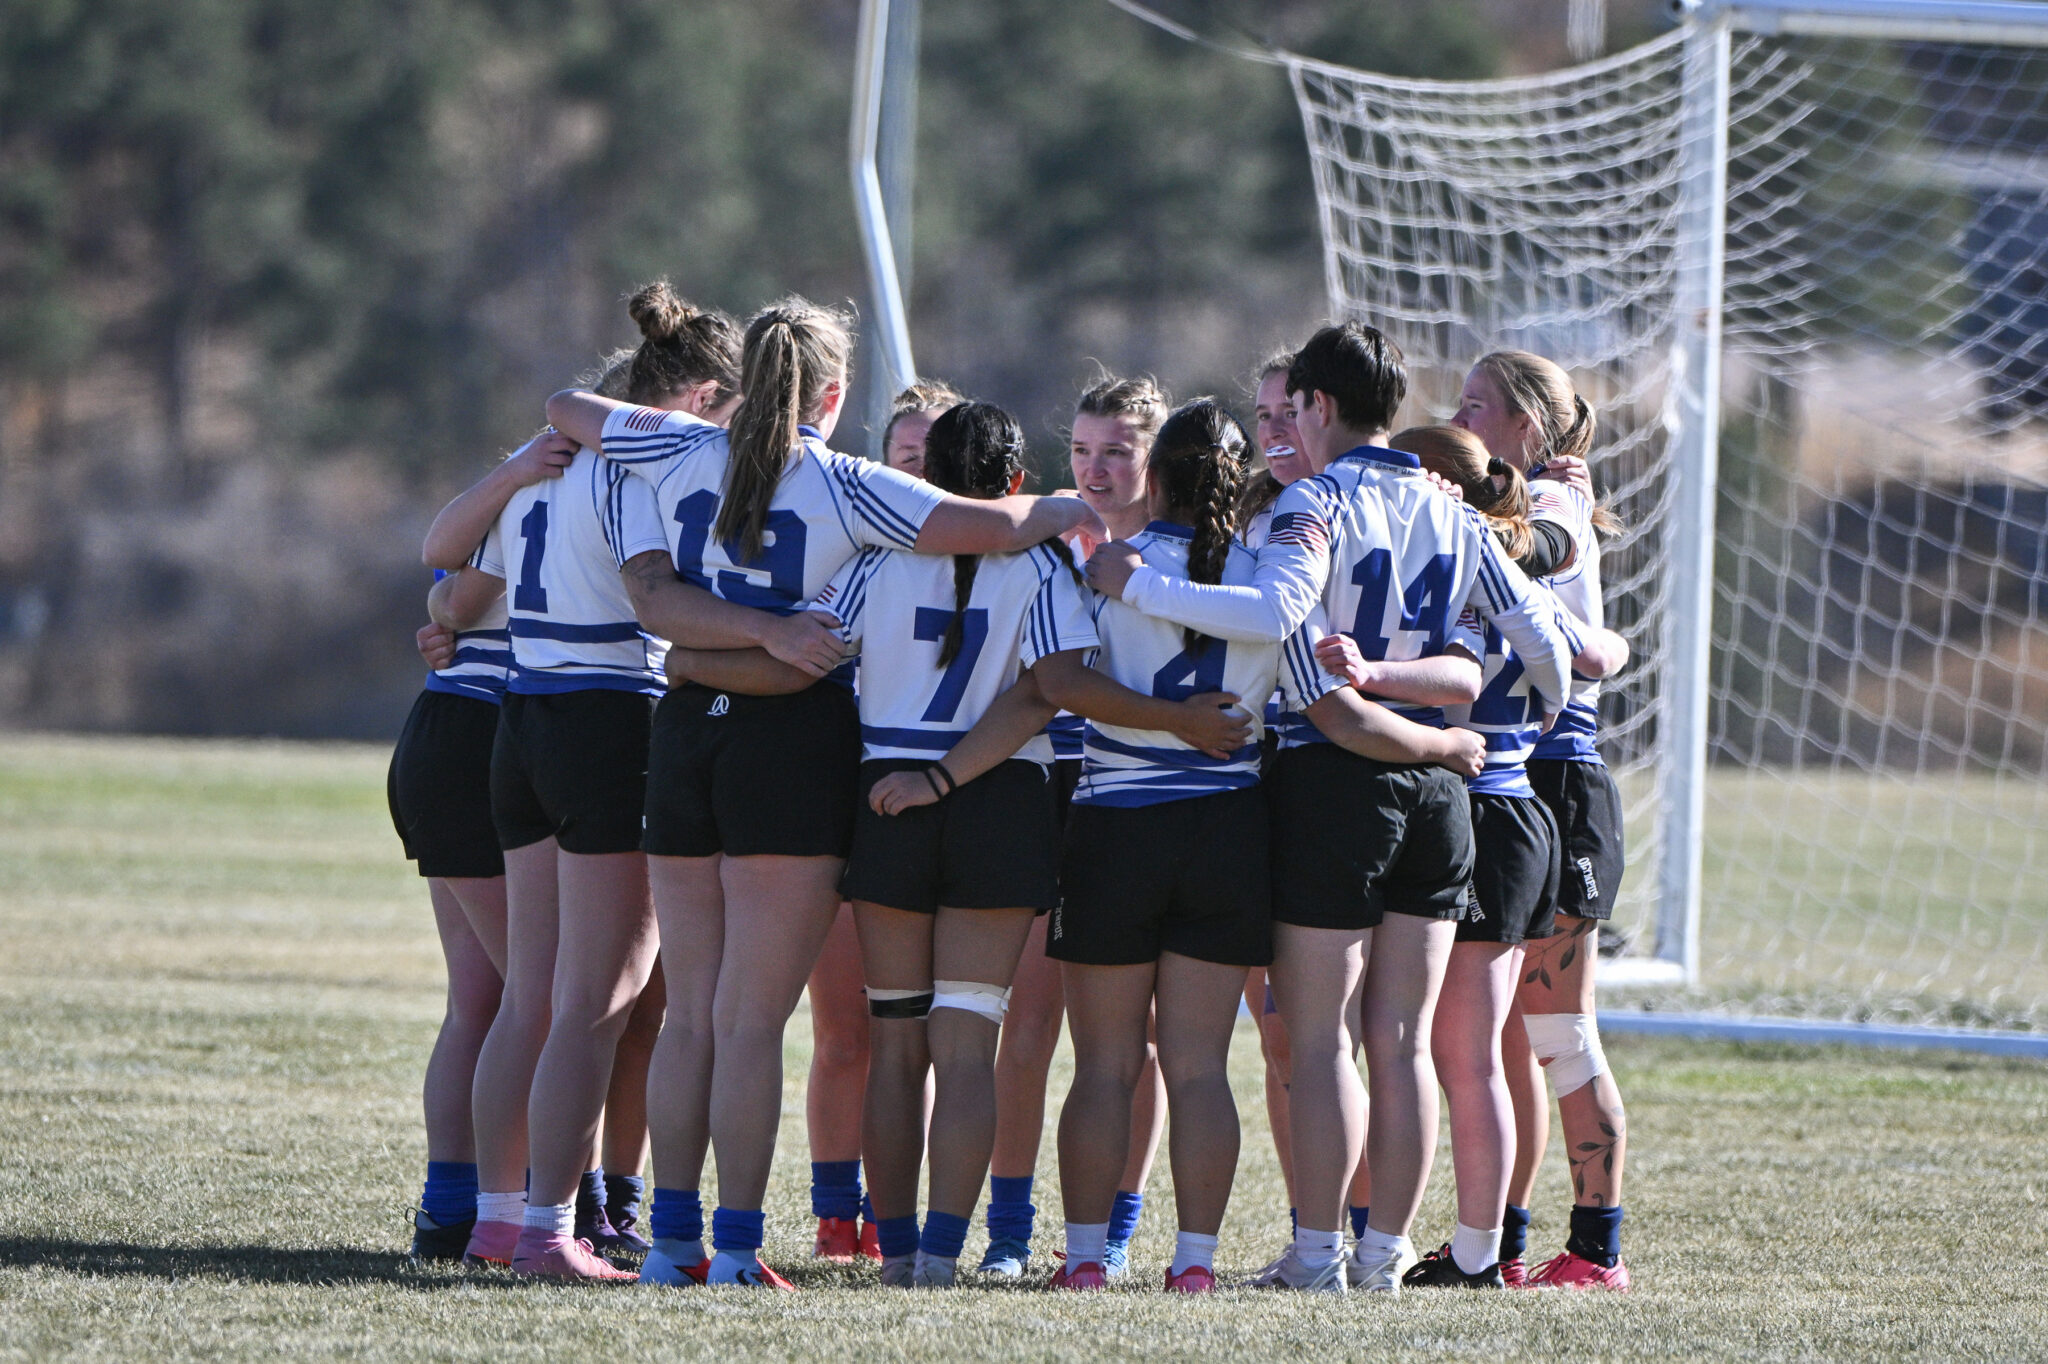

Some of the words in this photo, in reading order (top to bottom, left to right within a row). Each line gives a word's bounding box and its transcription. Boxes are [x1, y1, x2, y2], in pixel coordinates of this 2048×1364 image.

[514, 500, 549, 614] 1
[674, 488, 807, 608] 19
[1351, 548, 1458, 661] 14
[914, 607, 988, 722] 7
[1152, 634, 1231, 709] 4
[1470, 621, 1543, 725] 2
[1577, 857, 1599, 900] OLYMPUS
